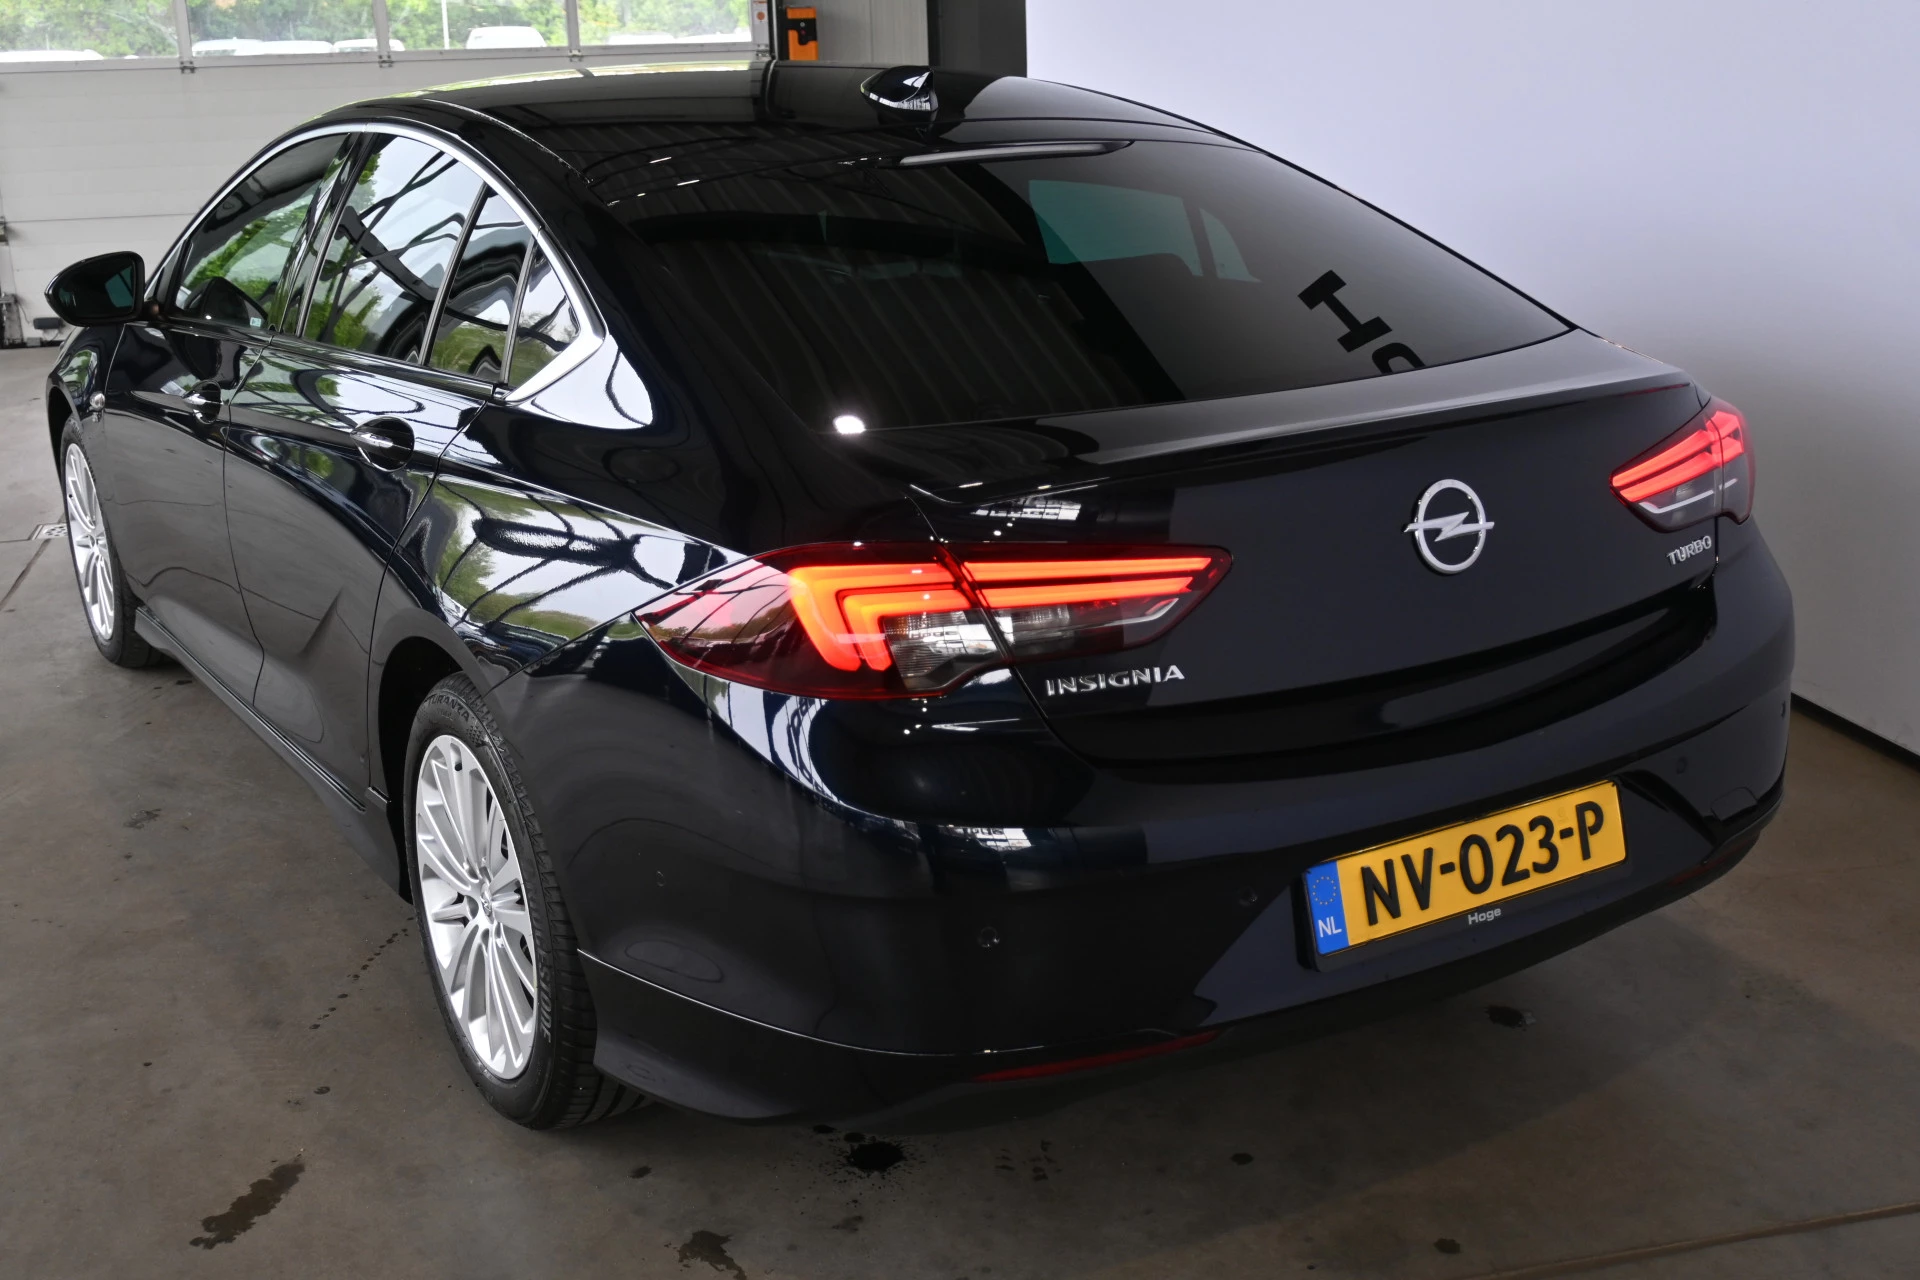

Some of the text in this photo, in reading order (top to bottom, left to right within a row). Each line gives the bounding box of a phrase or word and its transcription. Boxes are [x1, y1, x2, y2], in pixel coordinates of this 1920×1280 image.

[1666, 535, 1712, 565] TURBO
[1045, 664, 1185, 697] INSIGNIA
[1360, 800, 1605, 927] NV-023-P
[1318, 916, 1342, 938] NL
[1467, 908, 1502, 926] Hoge
